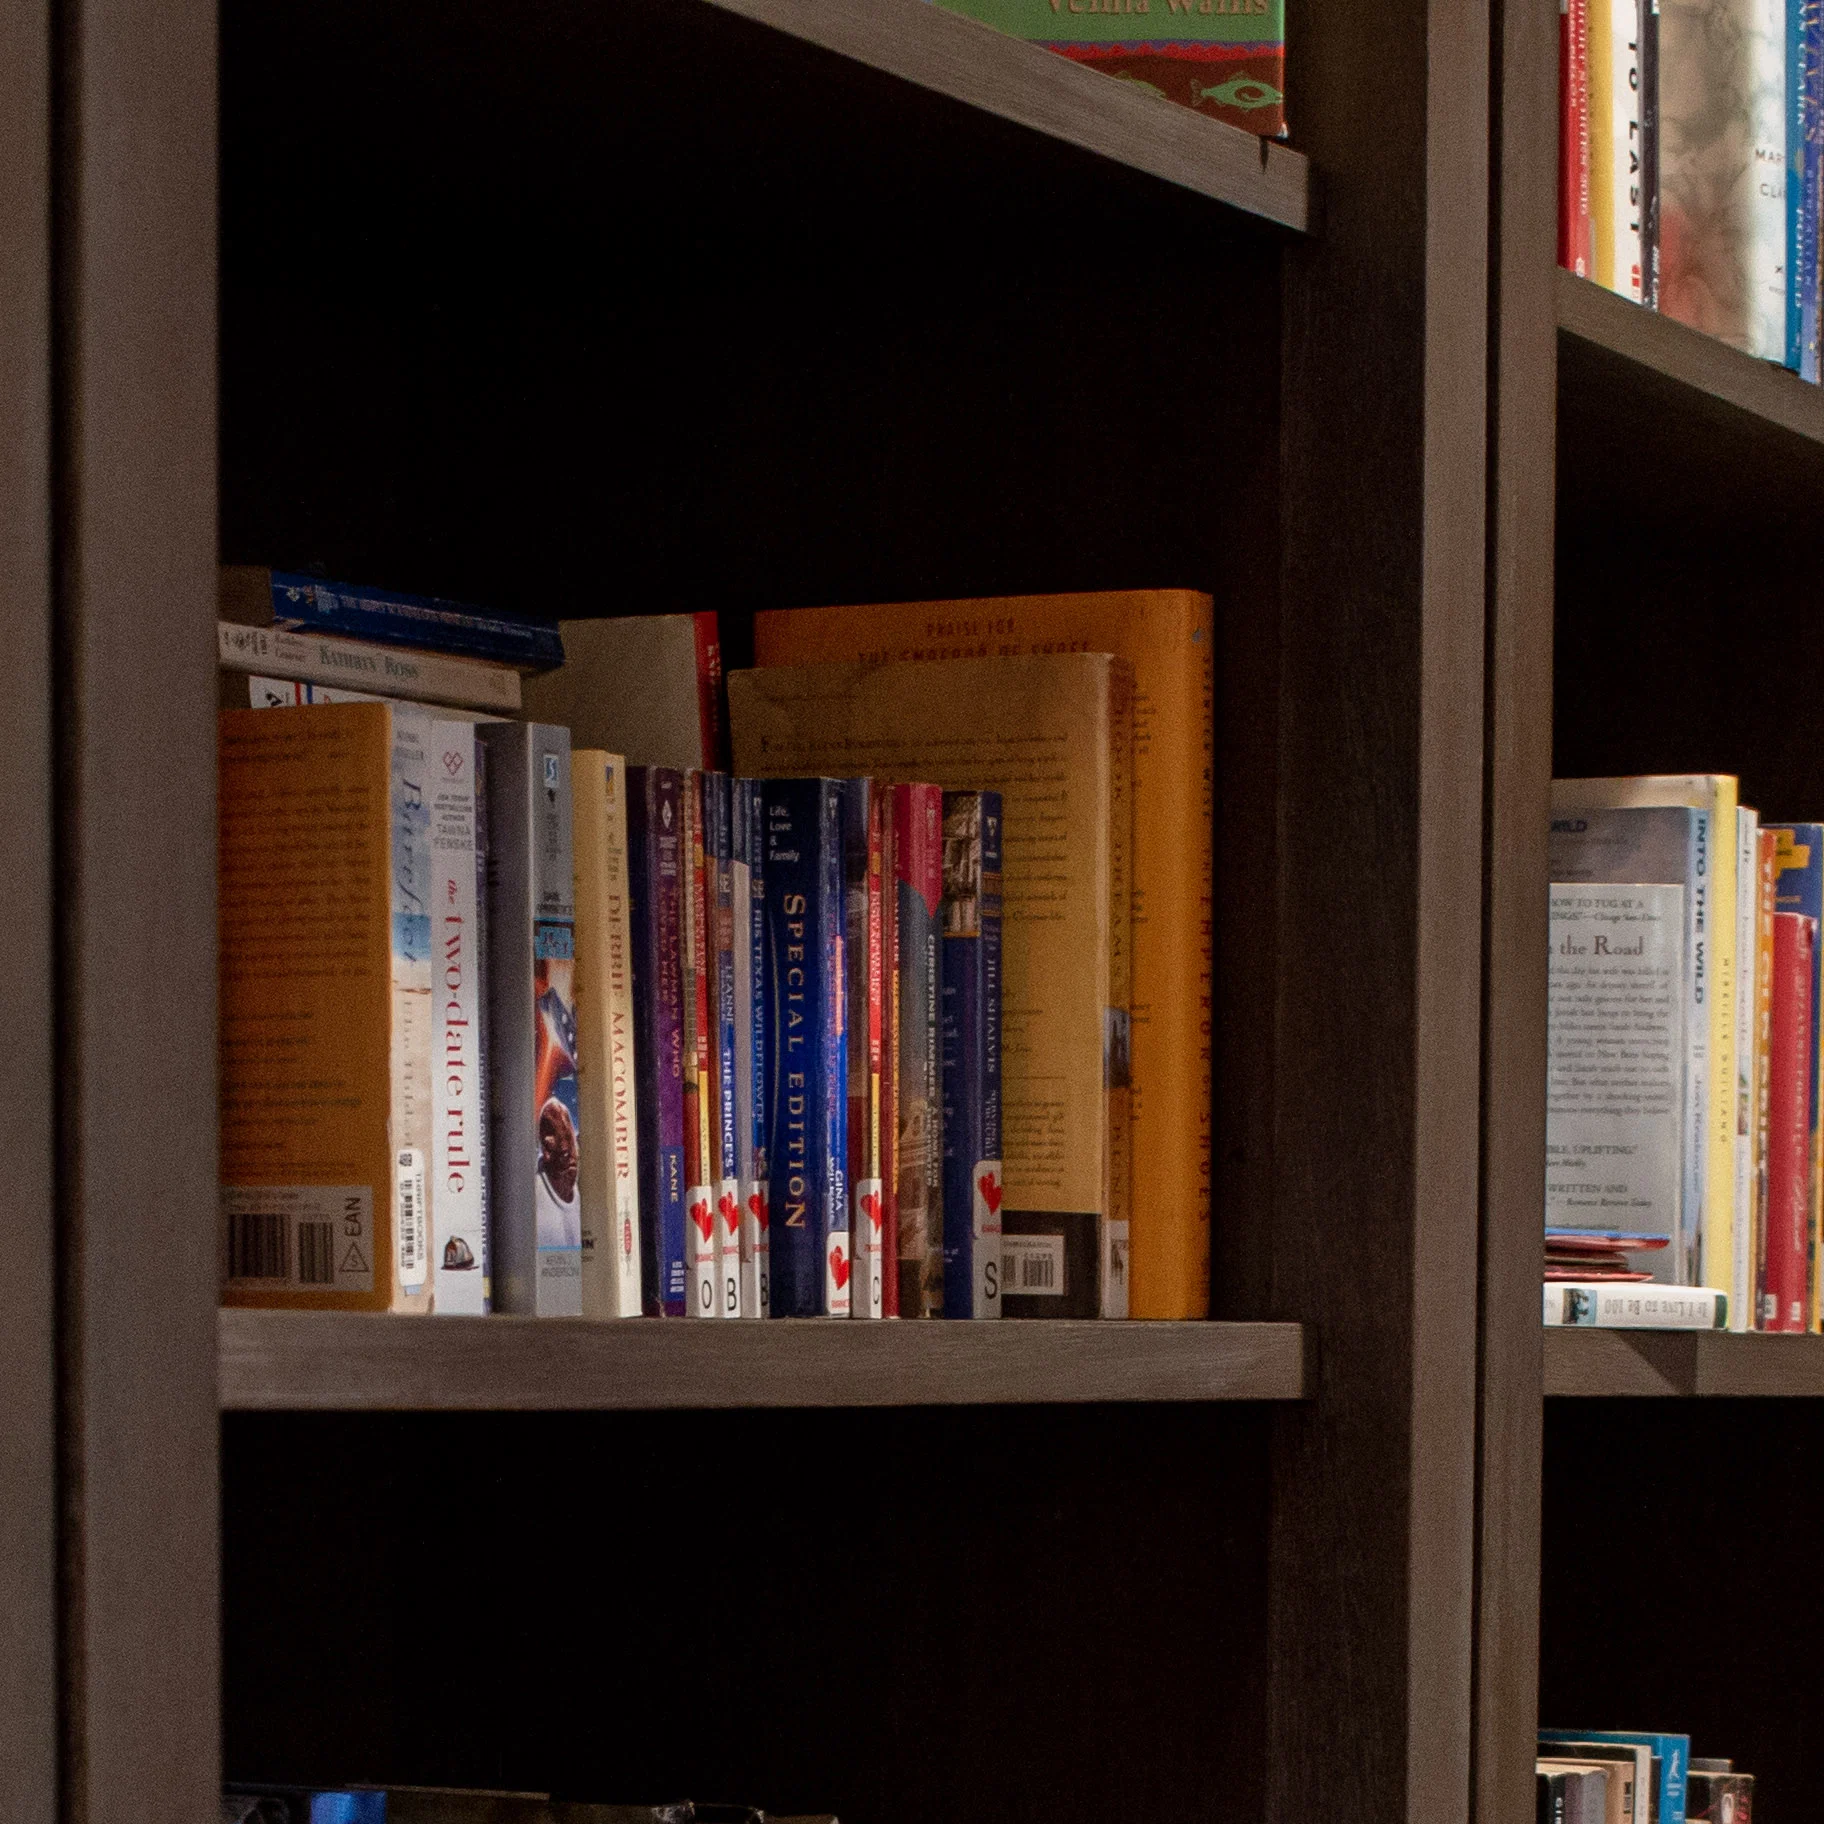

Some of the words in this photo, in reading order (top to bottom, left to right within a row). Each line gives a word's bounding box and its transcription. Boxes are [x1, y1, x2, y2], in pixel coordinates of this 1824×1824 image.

[443, 916, 467, 1096] two-date
[782, 894, 807, 1052] SPECIAL
[446, 1106, 470, 1194] rule
[784, 1073, 806, 1229] EDITION
[345, 1197, 364, 1236] EAN
[984, 1264, 1000, 1299] S
